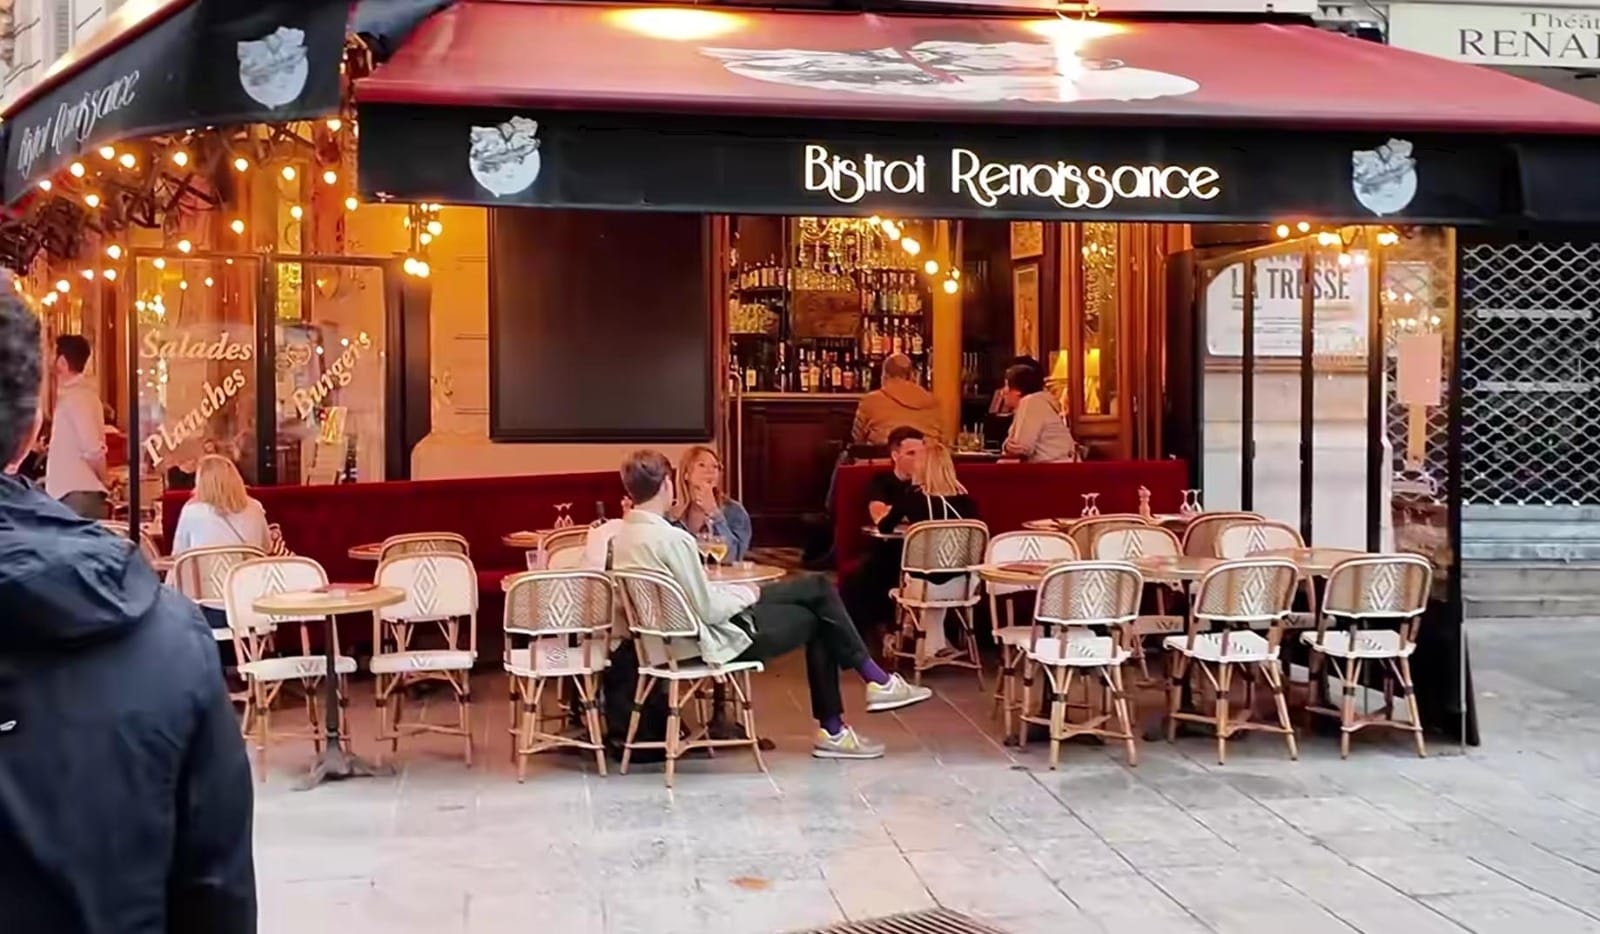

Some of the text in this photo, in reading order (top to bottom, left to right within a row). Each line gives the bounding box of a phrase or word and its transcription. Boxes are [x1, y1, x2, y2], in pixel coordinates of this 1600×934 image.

[805, 144, 1221, 208] Bistrot Renaissance
[139, 329, 253, 361] Salades
[292, 330, 372, 420] Burgers
[143, 367, 246, 467] Planches
